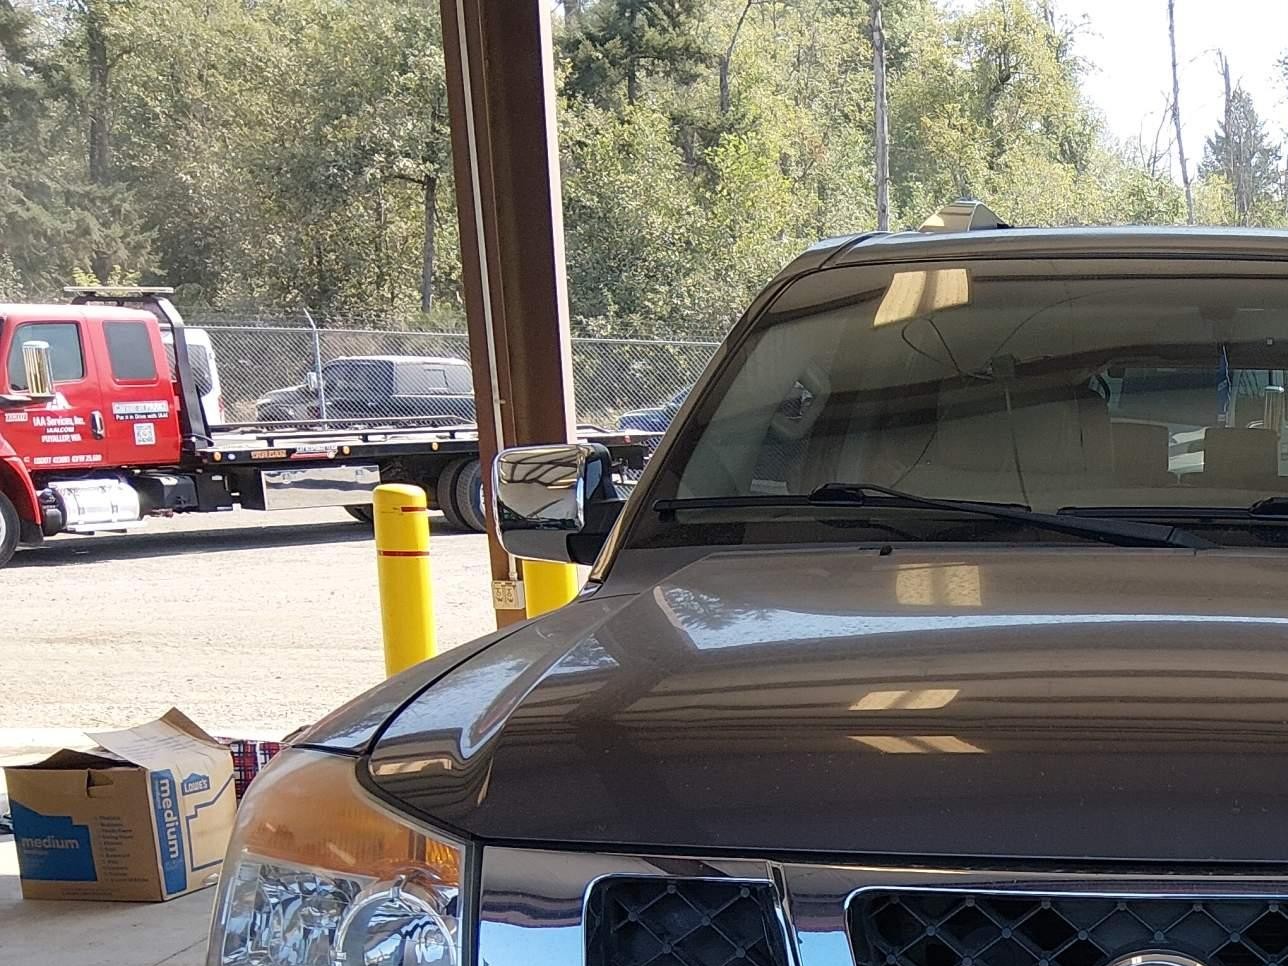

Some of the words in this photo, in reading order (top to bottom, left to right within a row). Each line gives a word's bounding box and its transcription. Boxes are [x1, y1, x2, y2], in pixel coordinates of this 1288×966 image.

[183, 779, 209, 793] LOWE'S
[159, 778, 180, 859] medium
[21, 835, 80, 849] medium
